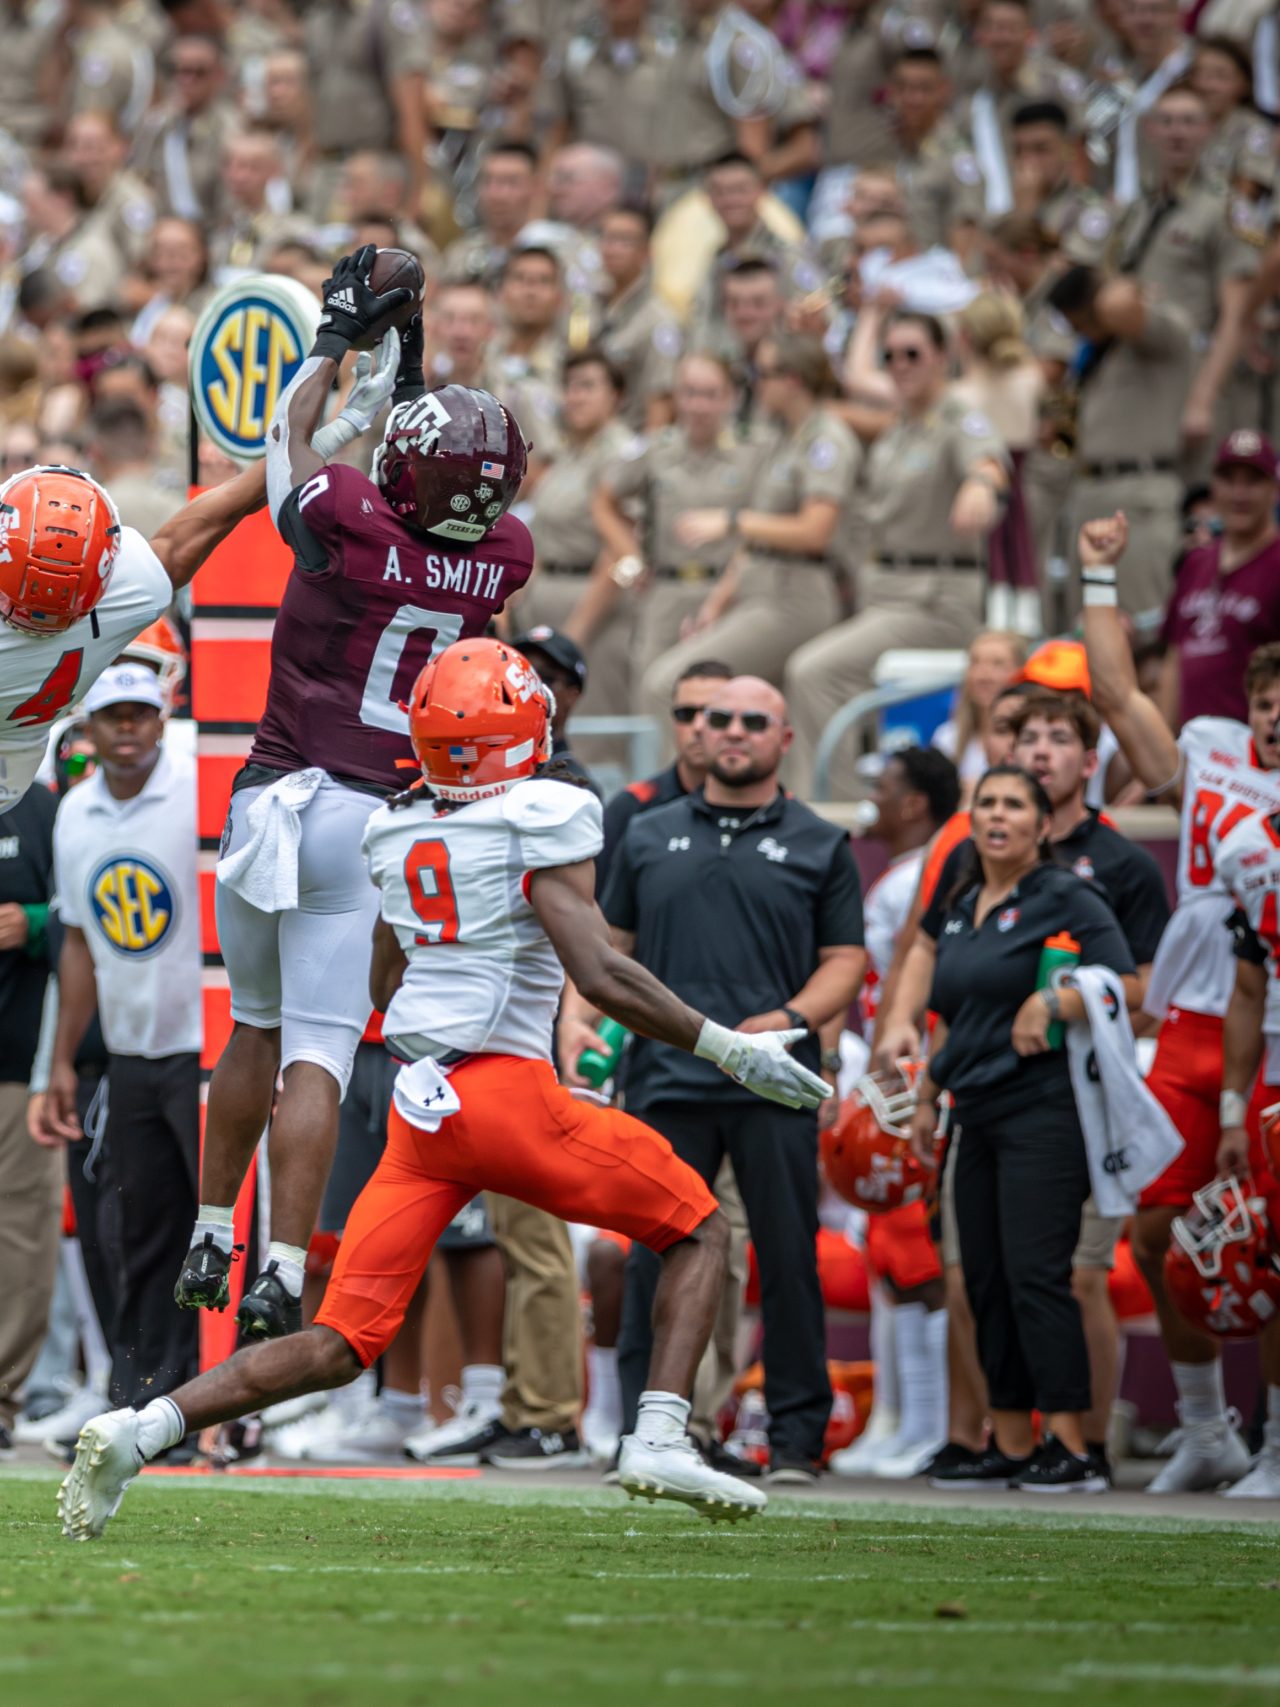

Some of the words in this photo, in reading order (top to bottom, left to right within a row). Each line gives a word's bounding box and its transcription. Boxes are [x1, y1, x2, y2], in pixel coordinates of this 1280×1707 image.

[327, 297, 358, 314] adidas
[208, 304, 299, 440] SEC
[446, 523, 471, 534] TEXAS
[383, 545, 412, 584] A.
[426, 554, 504, 600] SMITH
[6, 647, 85, 728] 4
[359, 604, 464, 736] 0
[438, 784, 506, 801] Riddell
[95, 864, 169, 949] SEC
[404, 837, 460, 946] 9
